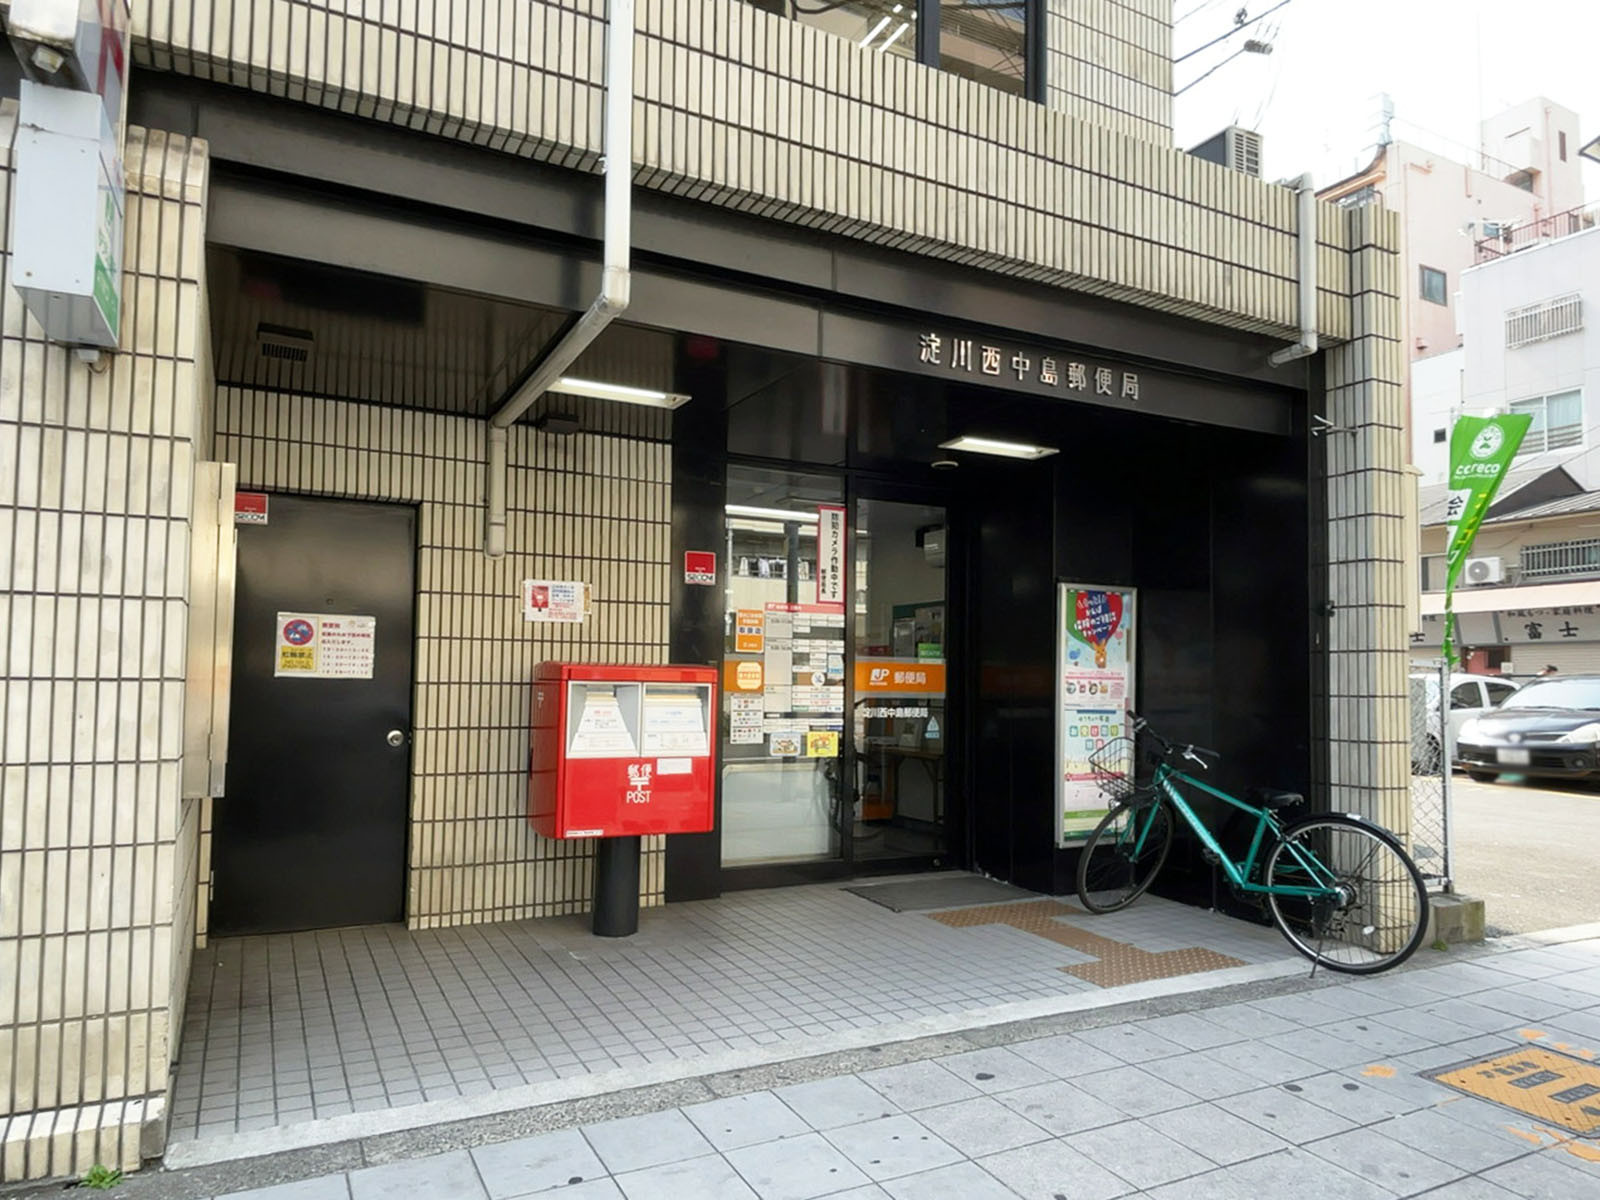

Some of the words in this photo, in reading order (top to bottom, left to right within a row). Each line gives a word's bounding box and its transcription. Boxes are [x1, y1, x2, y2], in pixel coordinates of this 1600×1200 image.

[919, 333, 1139, 400] 淀川西中島郵便局
[687, 573, 714, 581] SECOM
[1524, 621, 1579, 640] 富士
[894, 671, 926, 685] 郵便局
[626, 791, 652, 804] POST
